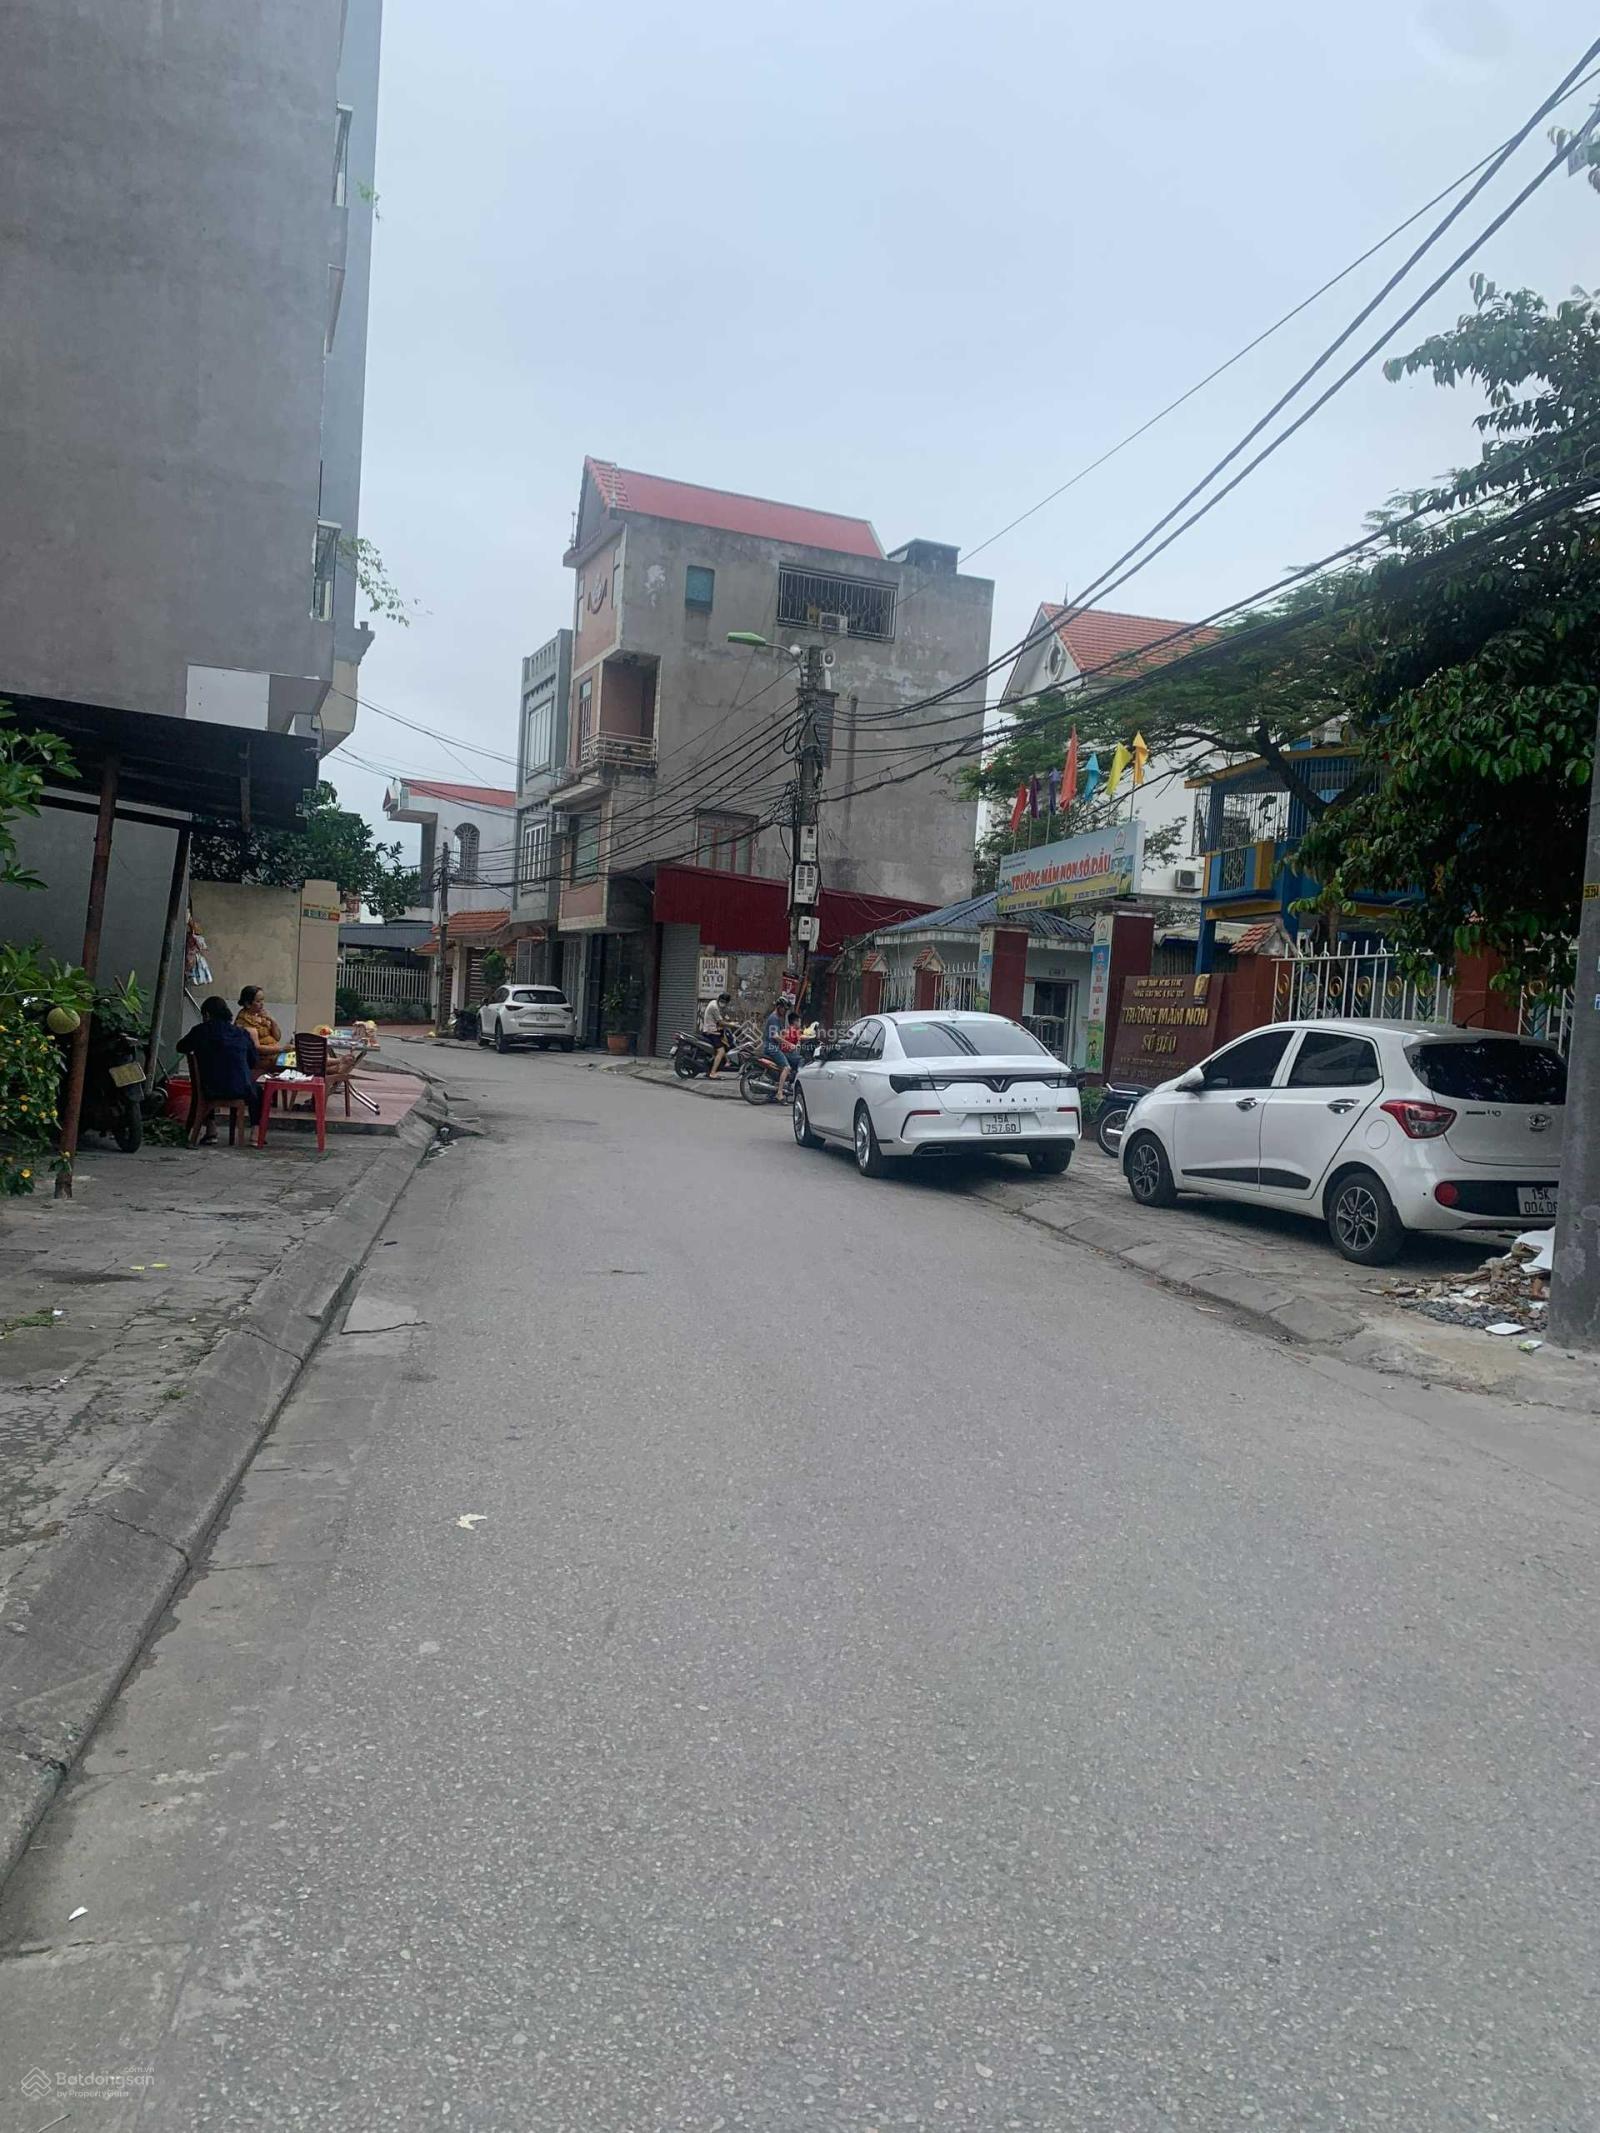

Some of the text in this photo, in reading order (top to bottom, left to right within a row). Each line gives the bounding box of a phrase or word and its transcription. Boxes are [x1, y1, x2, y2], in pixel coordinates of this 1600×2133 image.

[1011, 868, 1041, 890] TRƯỜNG
[1061, 862, 1078, 880] NON
[1122, 1004, 1157, 1025] TRƯỜNG
[1185, 1007, 1209, 1026] NON
[993, 1114, 1009, 1123] 15A
[986, 1123, 1017, 1133] 757.60
[1532, 1188, 1551, 1201] 15K
